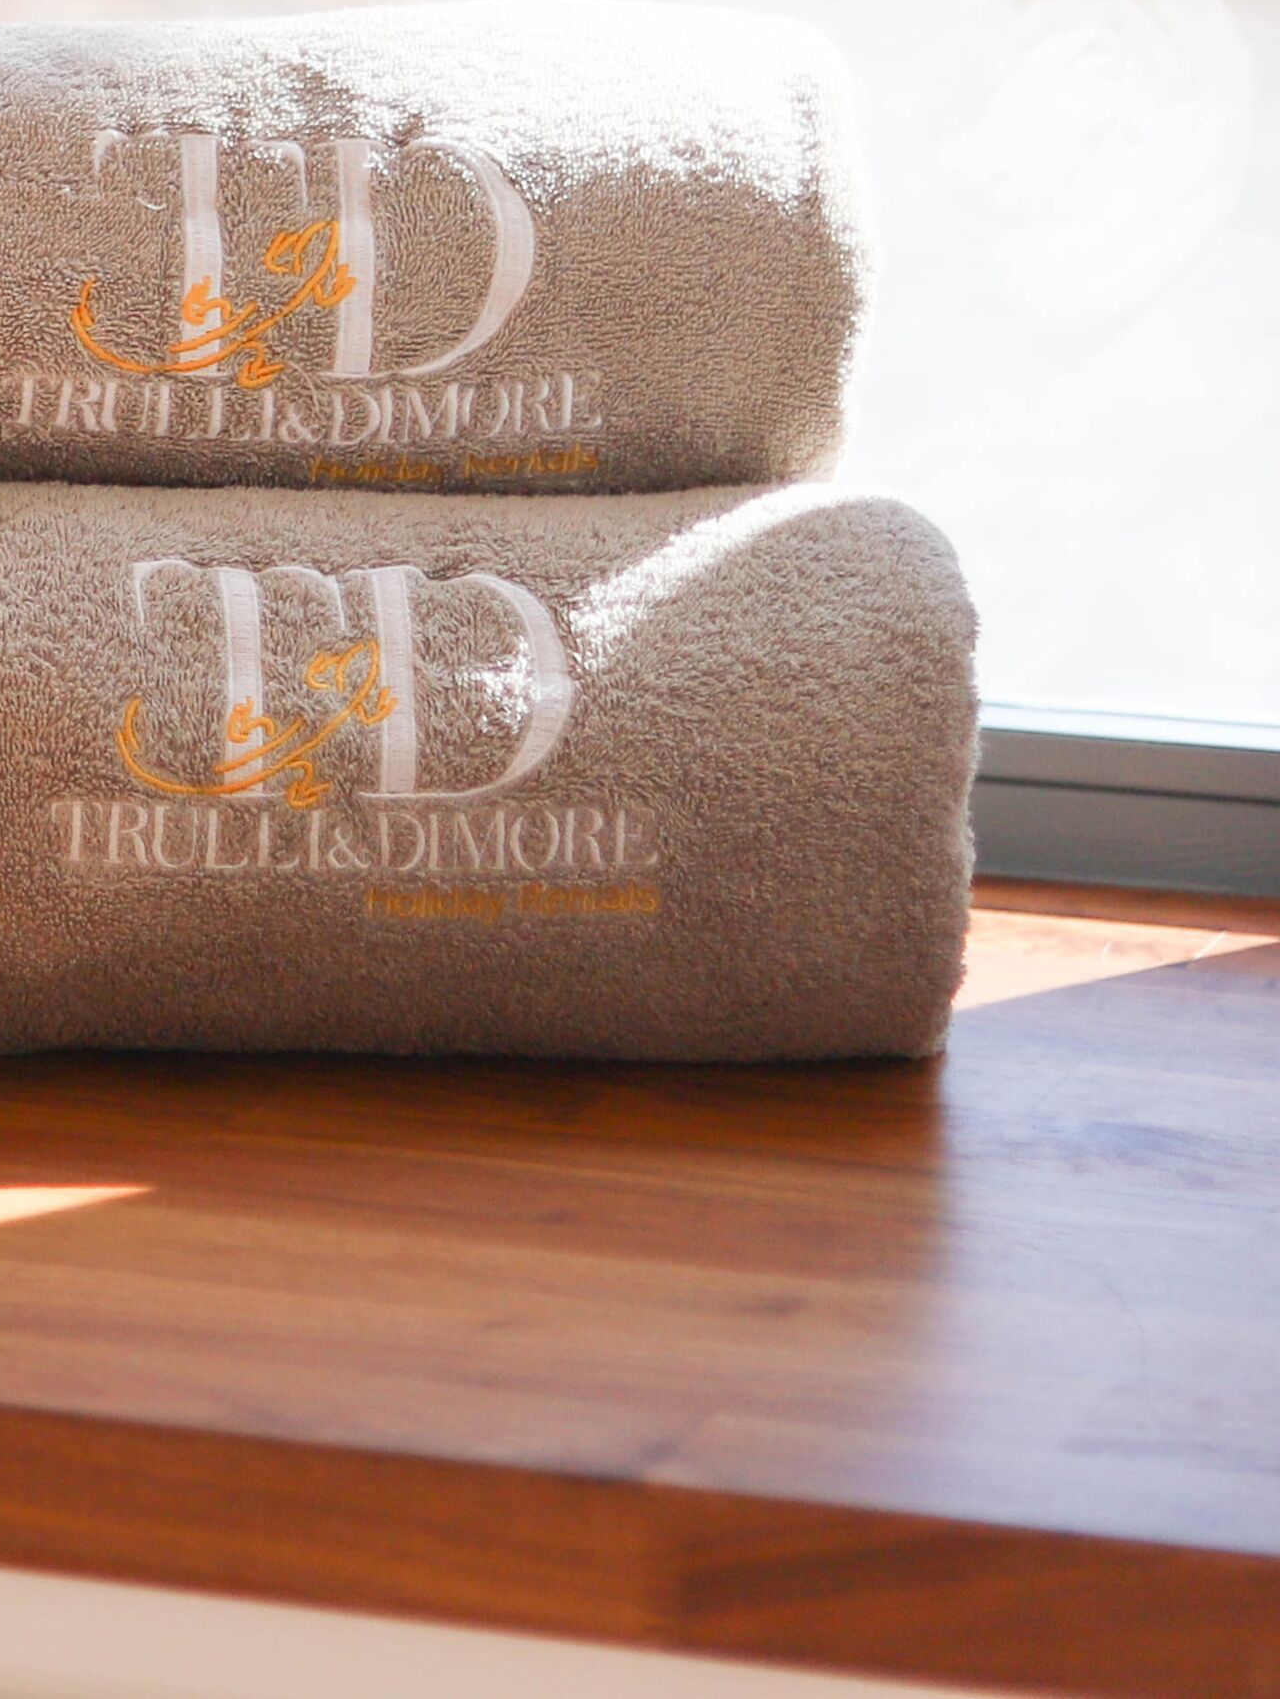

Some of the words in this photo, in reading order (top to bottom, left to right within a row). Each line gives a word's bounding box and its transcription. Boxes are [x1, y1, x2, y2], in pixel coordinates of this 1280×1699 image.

[2, 371, 601, 447] TRULLI&DIMORE
[132, 559, 576, 799] TD
[51, 800, 658, 871] TRULLI&DIMORE
